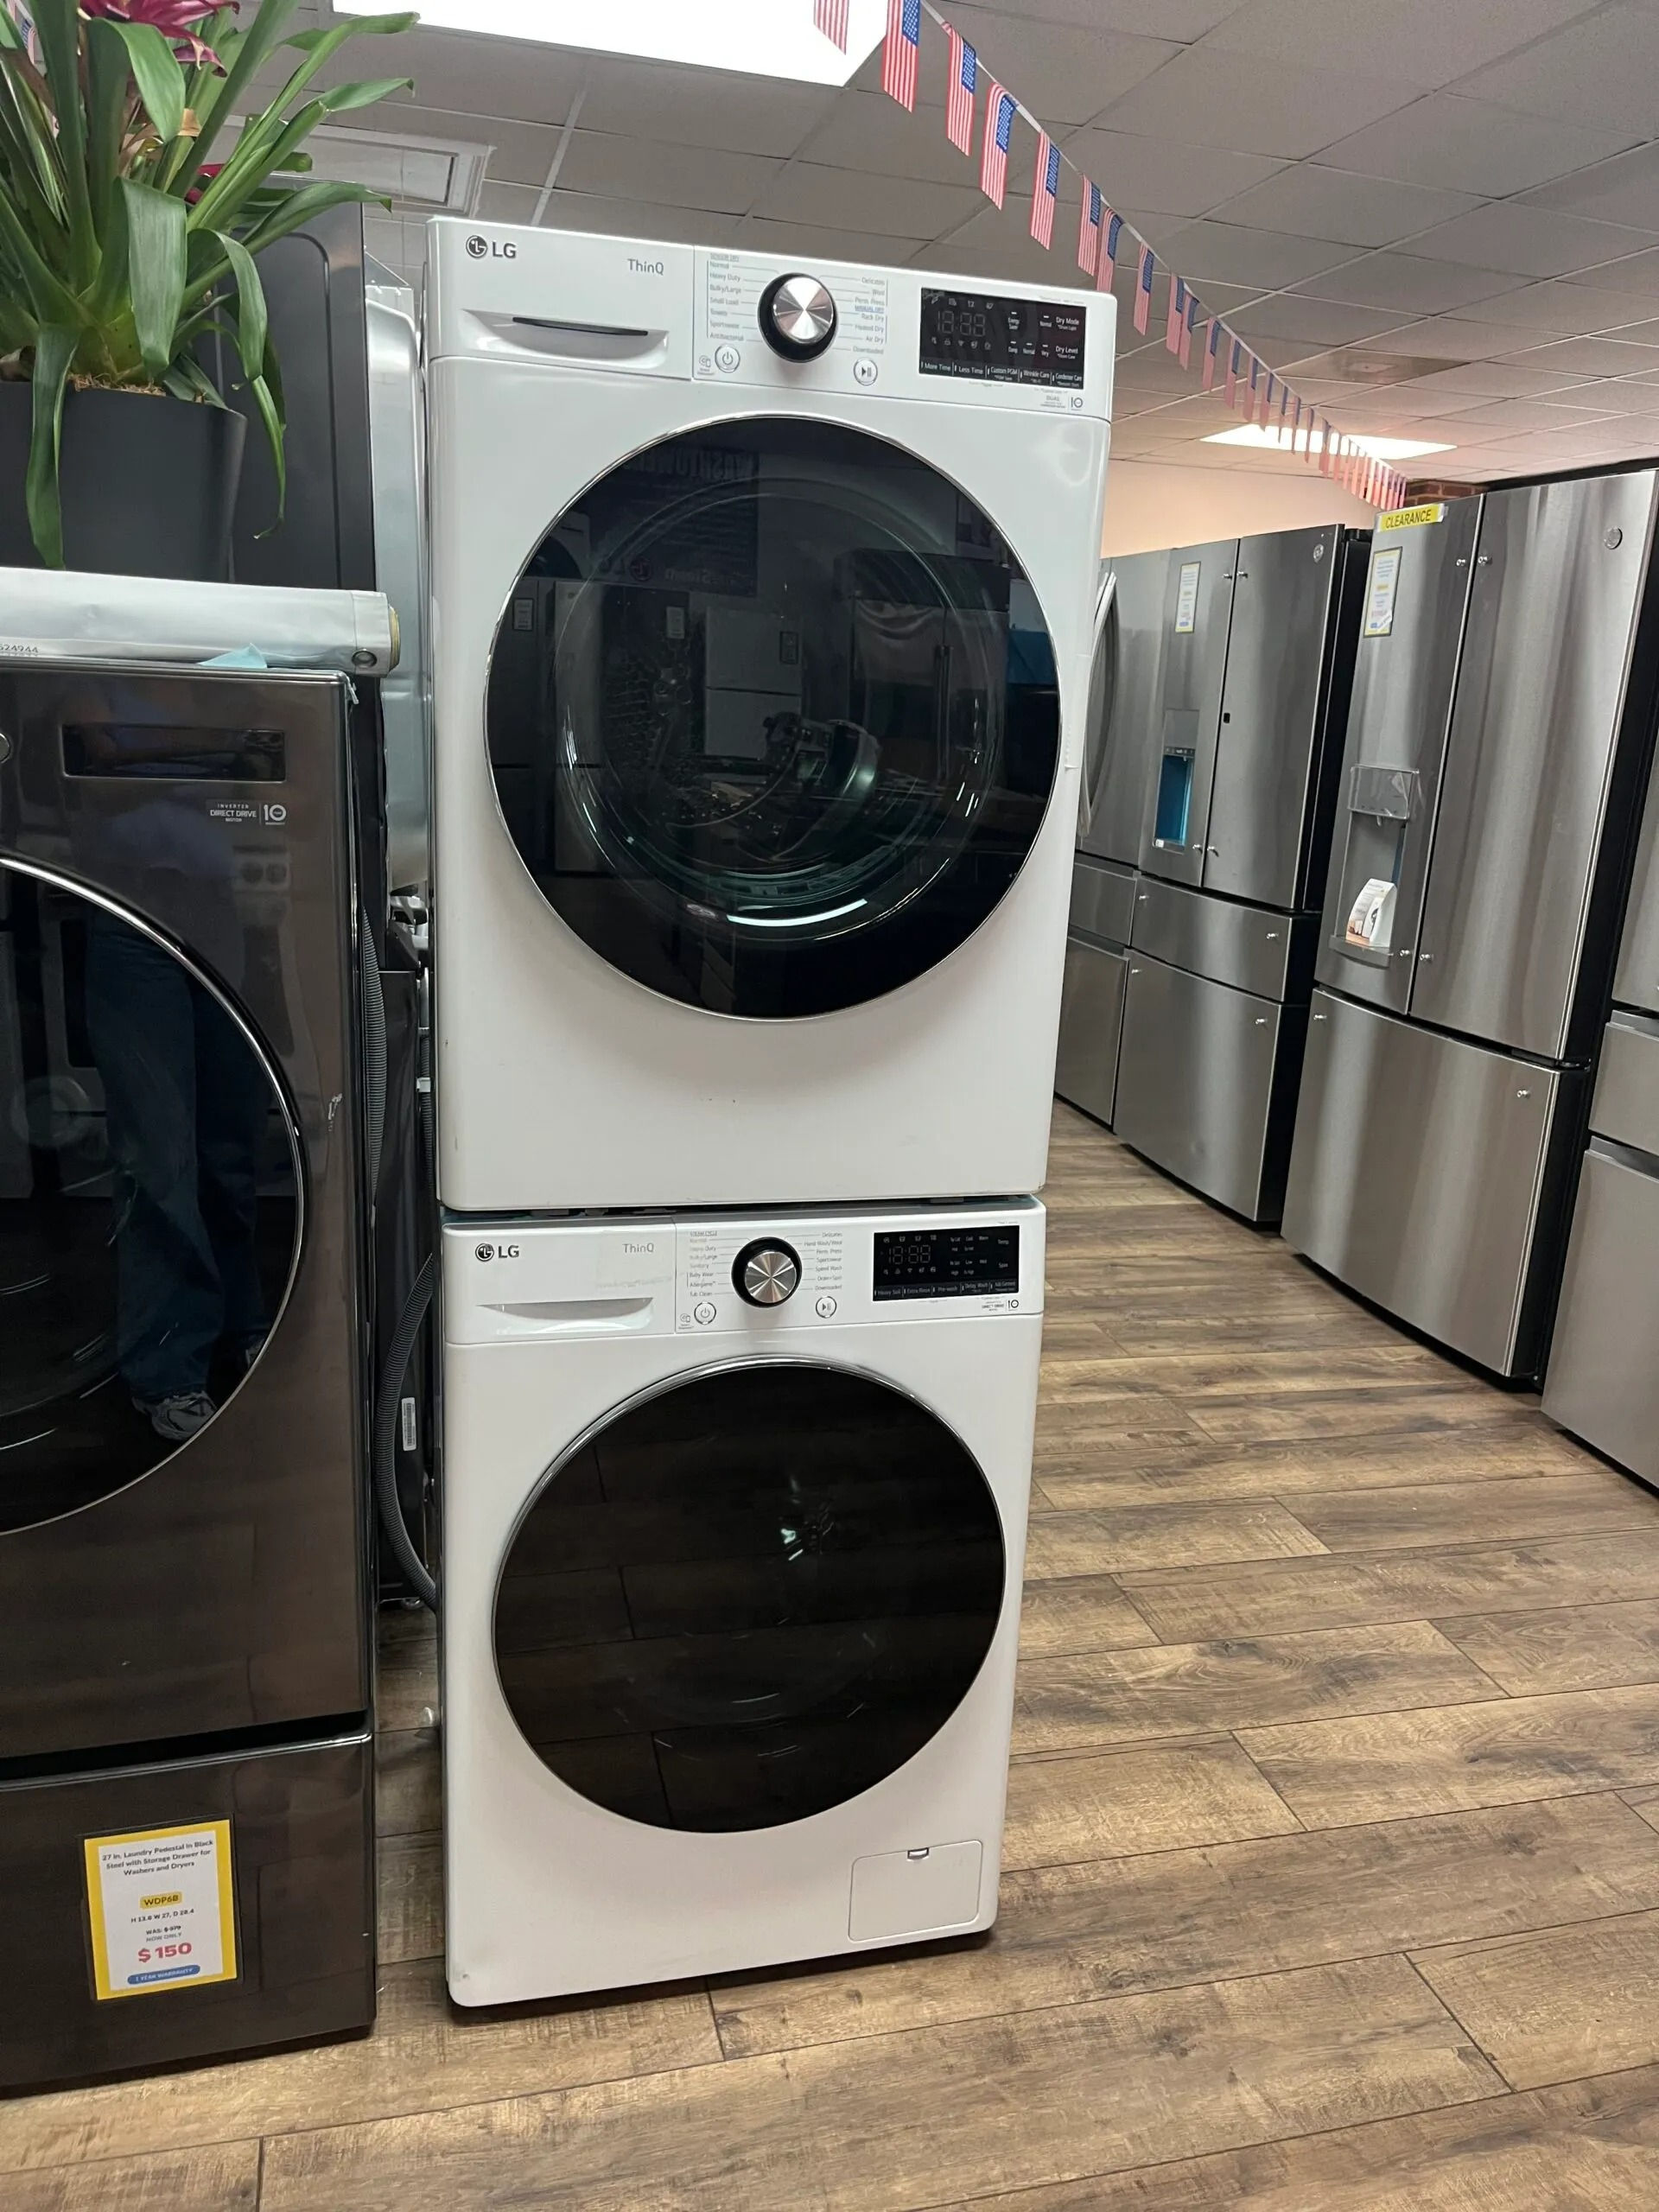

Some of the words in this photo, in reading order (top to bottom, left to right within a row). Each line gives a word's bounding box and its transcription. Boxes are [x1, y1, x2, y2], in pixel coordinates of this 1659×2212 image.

[493, 241, 517, 259] LG
[627, 258, 664, 276] ThinQ
[1056, 316, 1065, 325] Dry
[1385, 509, 1432, 529] CLEARANCE
[264, 804, 287, 822] 10
[498, 1245, 520, 1259] LG
[623, 1243, 655, 1254] ThinQ
[124, 1849, 152, 1859] Laundry
[154, 1843, 185, 1853] Pedestal
[194, 1840, 213, 1848] Black
[143, 1855, 171, 1866] Storage
[172, 1852, 199, 1860] Drawer
[124, 1867, 155, 1876] Washers
[170, 1861, 195, 1870] Dryers
[143, 1894, 179, 1906] WDP6B
[138, 1948, 151, 1963] $
[155, 1942, 192, 1959] 150
